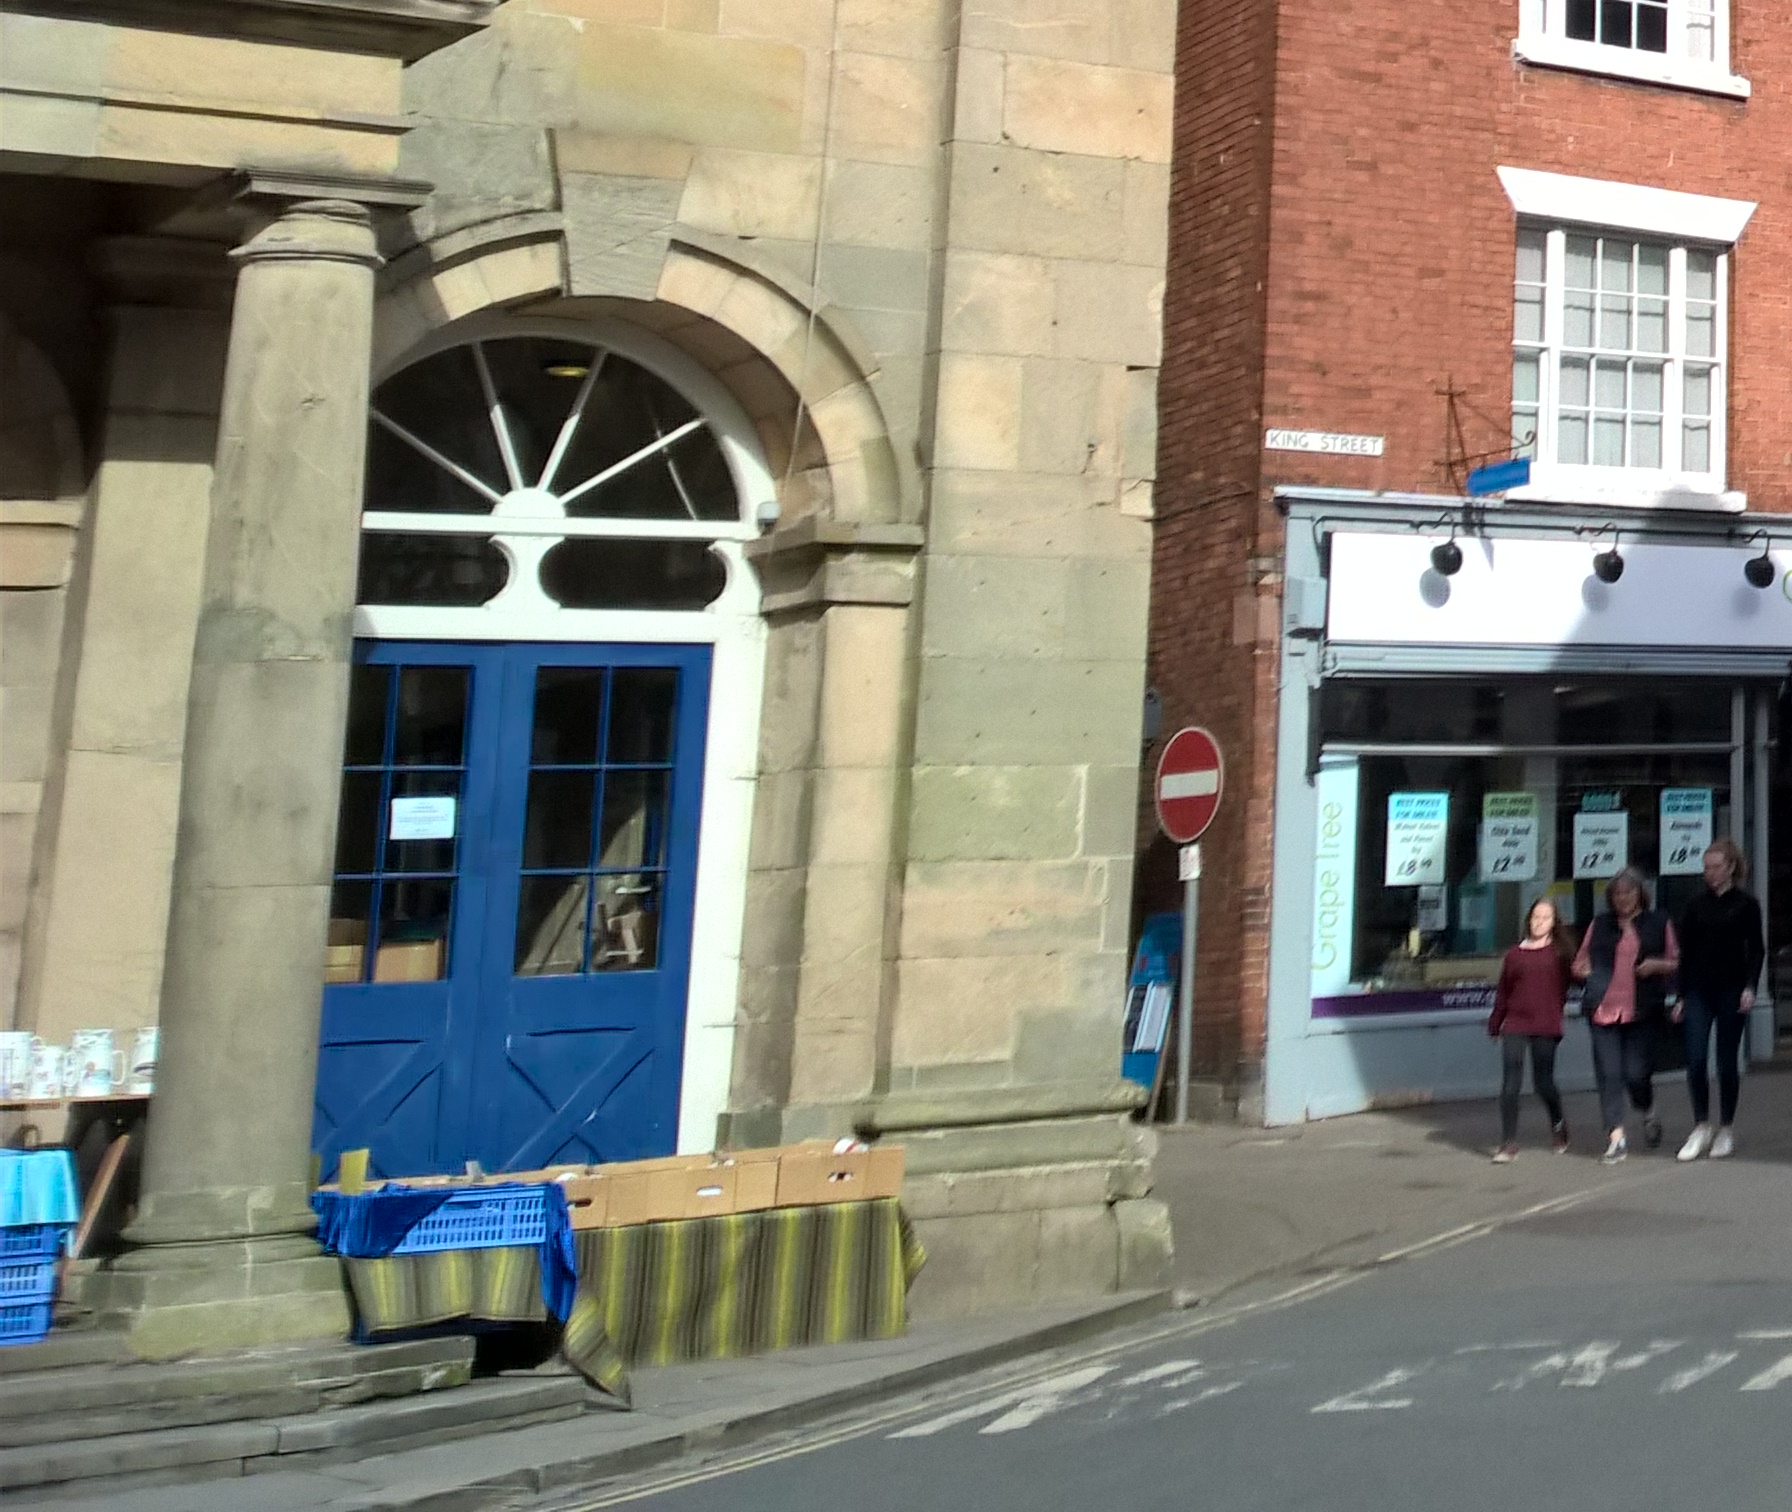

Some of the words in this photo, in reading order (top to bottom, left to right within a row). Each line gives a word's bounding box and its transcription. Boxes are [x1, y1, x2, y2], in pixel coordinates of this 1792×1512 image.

[1269, 429, 1309, 449] KING
[1320, 434, 1382, 454] STREET
[1315, 801, 1343, 861] Tree
[1311, 869, 1347, 972] Grape
